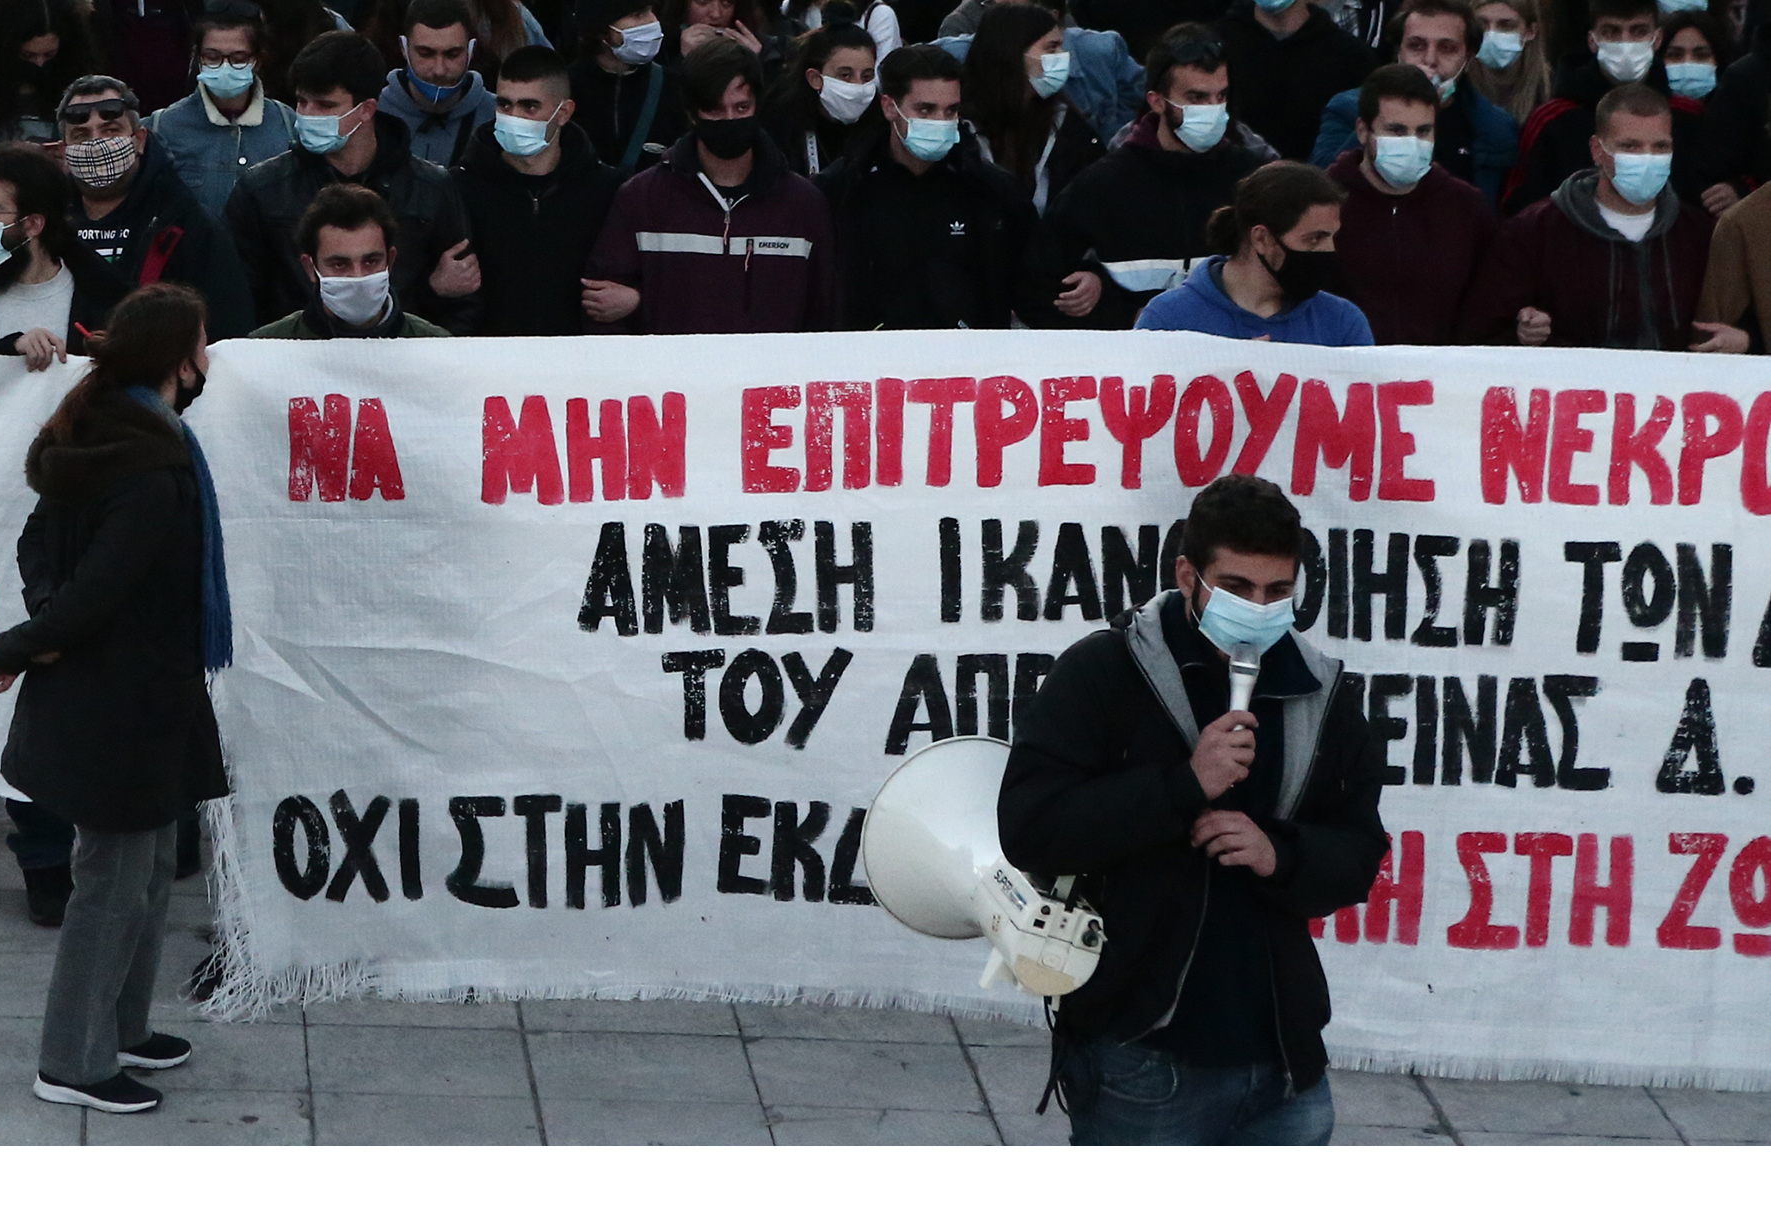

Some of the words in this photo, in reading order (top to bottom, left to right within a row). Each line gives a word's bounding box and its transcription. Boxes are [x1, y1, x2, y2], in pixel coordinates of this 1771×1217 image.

[758, 241, 790, 250] EMERSON
[288, 394, 405, 502] ΝΑ
[481, 392, 687, 505] ΜΗΝ
[741, 370, 1436, 503] ΕΠΙΤΡΕΨΟΥΜΕ
[577, 519, 875, 636] ΑΜΕΣΗ
[1564, 541, 1733, 662] ΤΩΝ
[662, 647, 854, 751] ΤΟΥ
[1655, 677, 1756, 796] Δ.
[273, 789, 424, 905] ΟΧΙ
[446, 794, 685, 909] ΣΤΗΝ
[1446, 830, 1634, 950] ΣΤΗ
